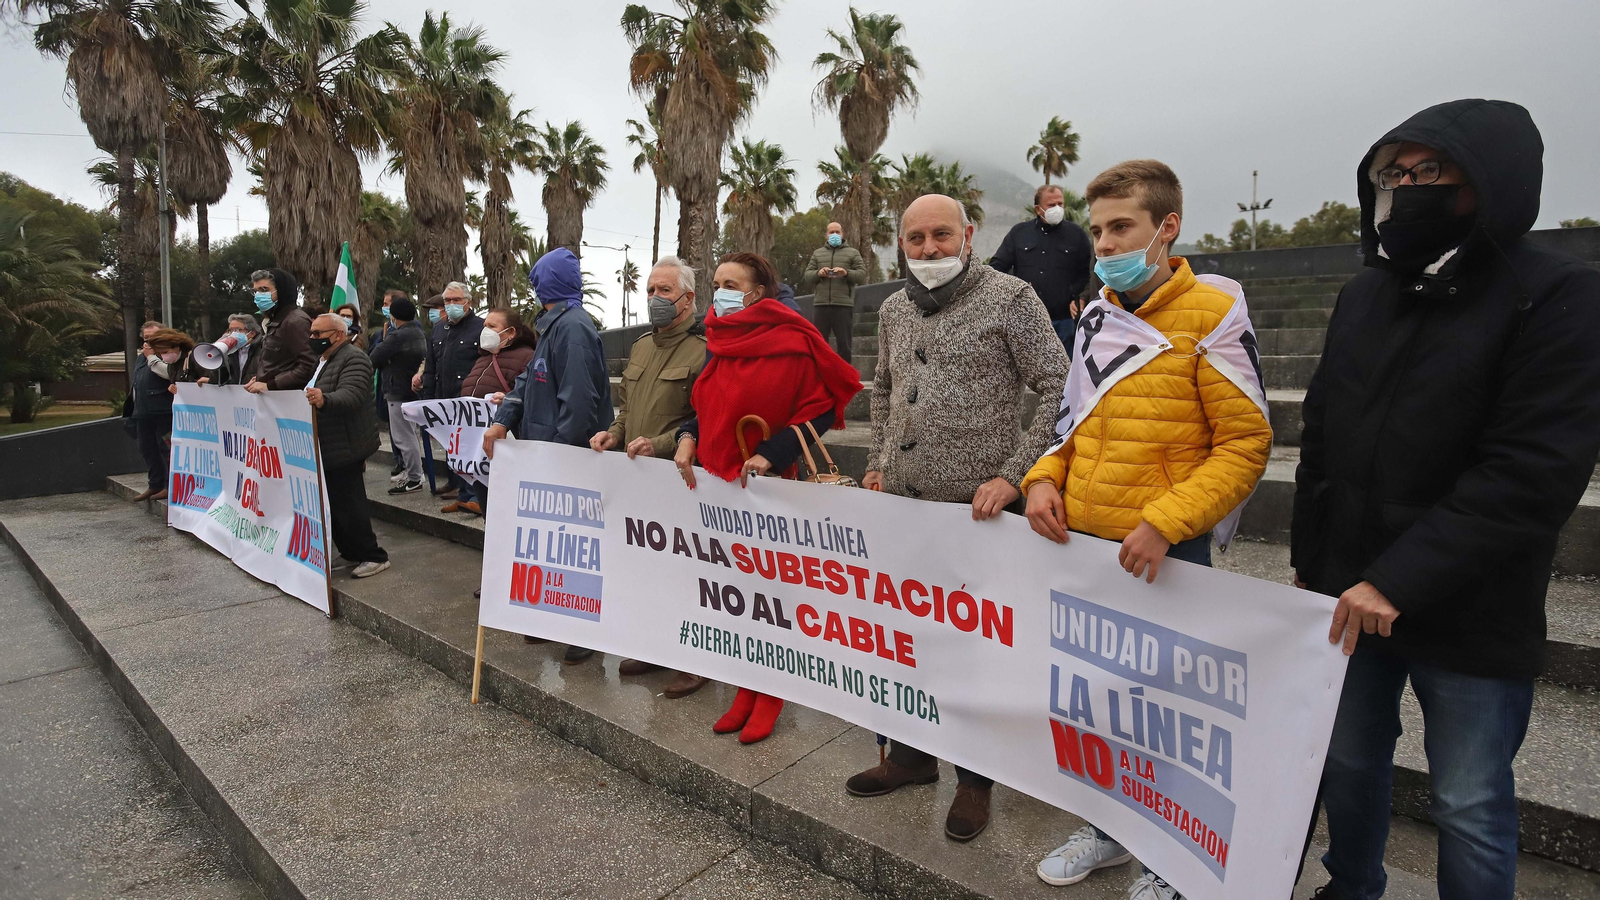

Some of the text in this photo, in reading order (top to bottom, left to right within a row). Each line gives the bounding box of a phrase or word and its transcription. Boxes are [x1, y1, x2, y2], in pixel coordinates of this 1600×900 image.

[175, 411, 204, 433] UNIDAD
[222, 430, 233, 458] NO
[233, 432, 239, 460] A
[448, 427, 462, 455] SÍ
[174, 443, 221, 478] LA LÍNEA
[172, 473, 196, 506] NO
[288, 474, 304, 513] LA
[518, 487, 605, 522] UNIDAD POR
[288, 512, 311, 561] NO
[514, 524, 601, 572] LA LÍNEA
[699, 501, 869, 559] UNIDAD POR LA LÍNEA
[509, 562, 563, 605] NO A LA
[544, 589, 601, 614] SUBESTACION
[625, 517, 1014, 648] NO A LA SUBESTACIÓN
[698, 577, 917, 669] NO AL CABLE
[679, 620, 940, 725] #SIERRA CARBONERA NO SE TOCA
[1051, 600, 1247, 707] UNIDAD POR
[1050, 663, 1233, 793] LA LÍNEA
[1049, 716, 1156, 791] NO A LA
[1121, 774, 1229, 869] SUBESTACION
